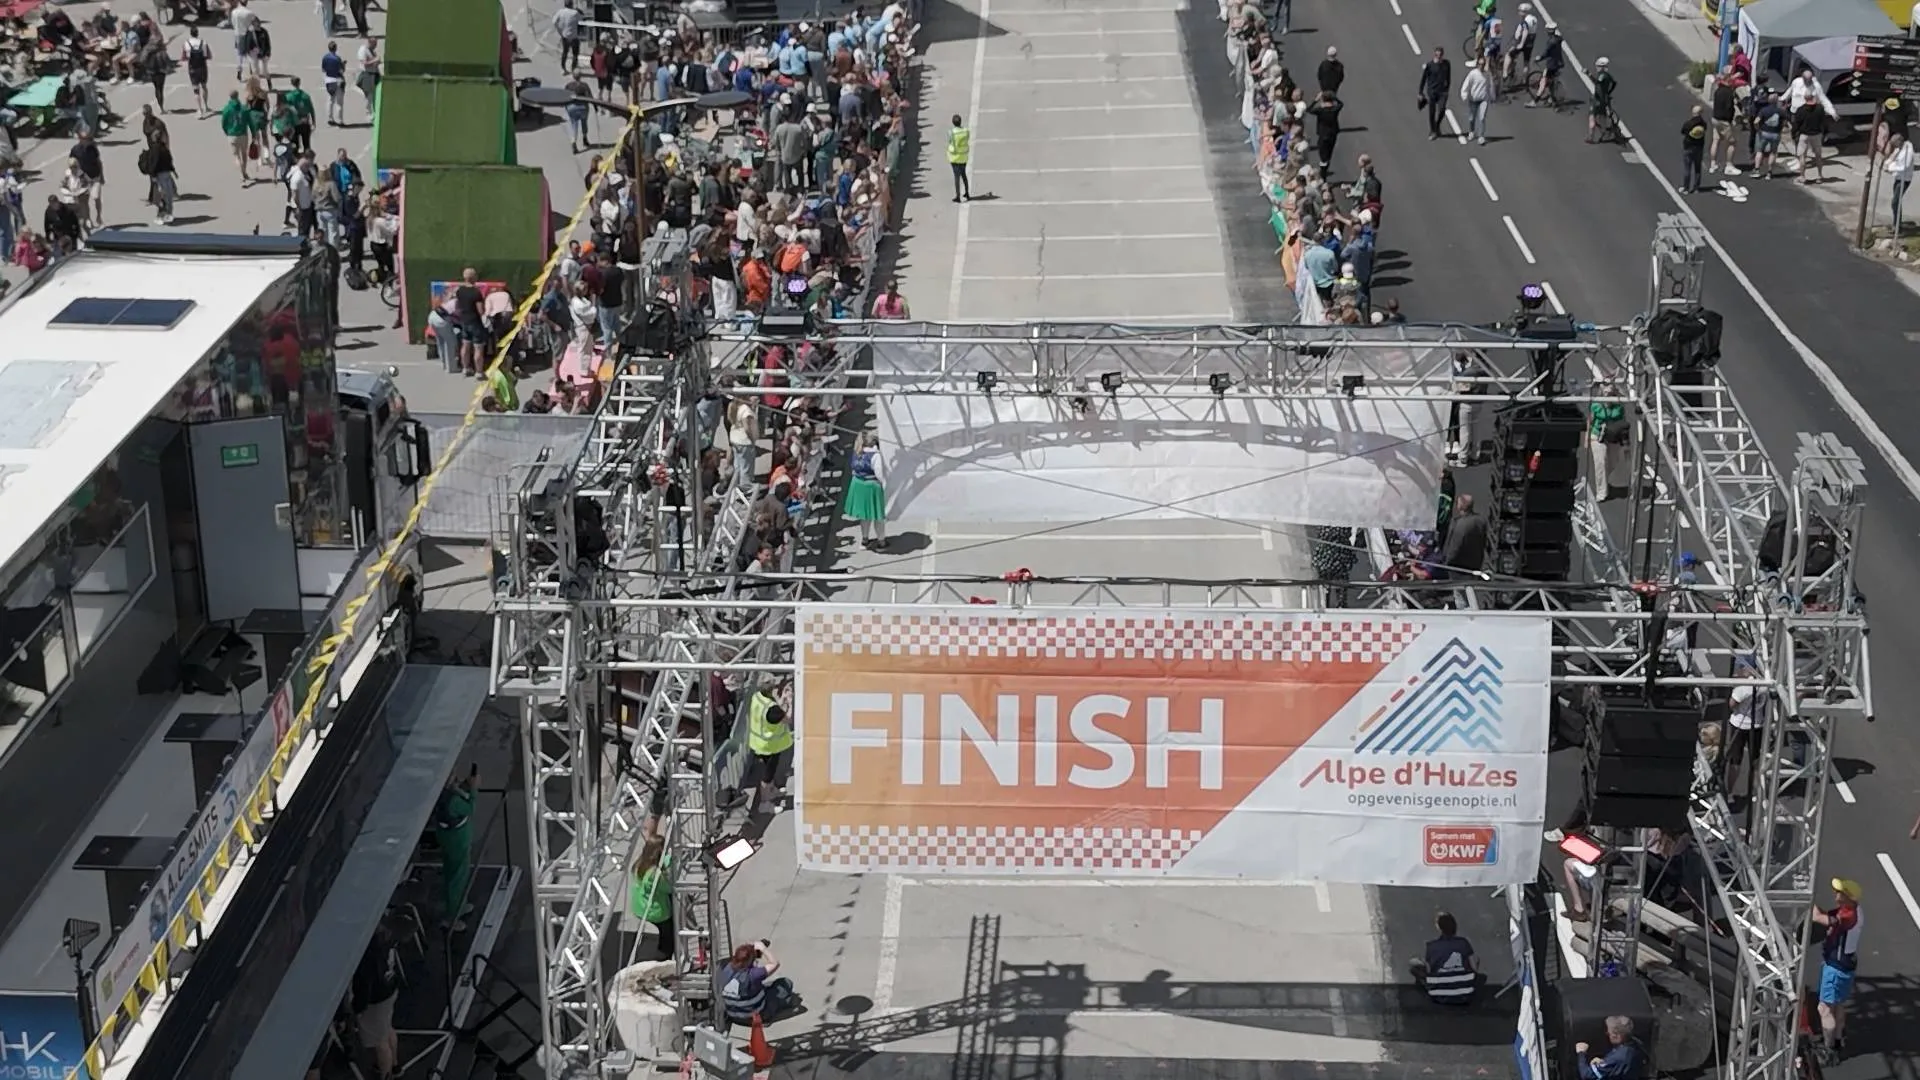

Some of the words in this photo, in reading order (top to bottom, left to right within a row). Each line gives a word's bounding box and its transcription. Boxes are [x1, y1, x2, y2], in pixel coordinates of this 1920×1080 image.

[830, 692, 1224, 790] FINISH
[1299, 758, 1386, 790] Alpe
[1394, 760, 1518, 788] d'HuZes
[1347, 792, 1518, 809] opgevenisgeenoptie.nl
[1430, 831, 1458, 841] Samen
[1460, 832, 1476, 840] met
[1448, 844, 1487, 858] KWF
